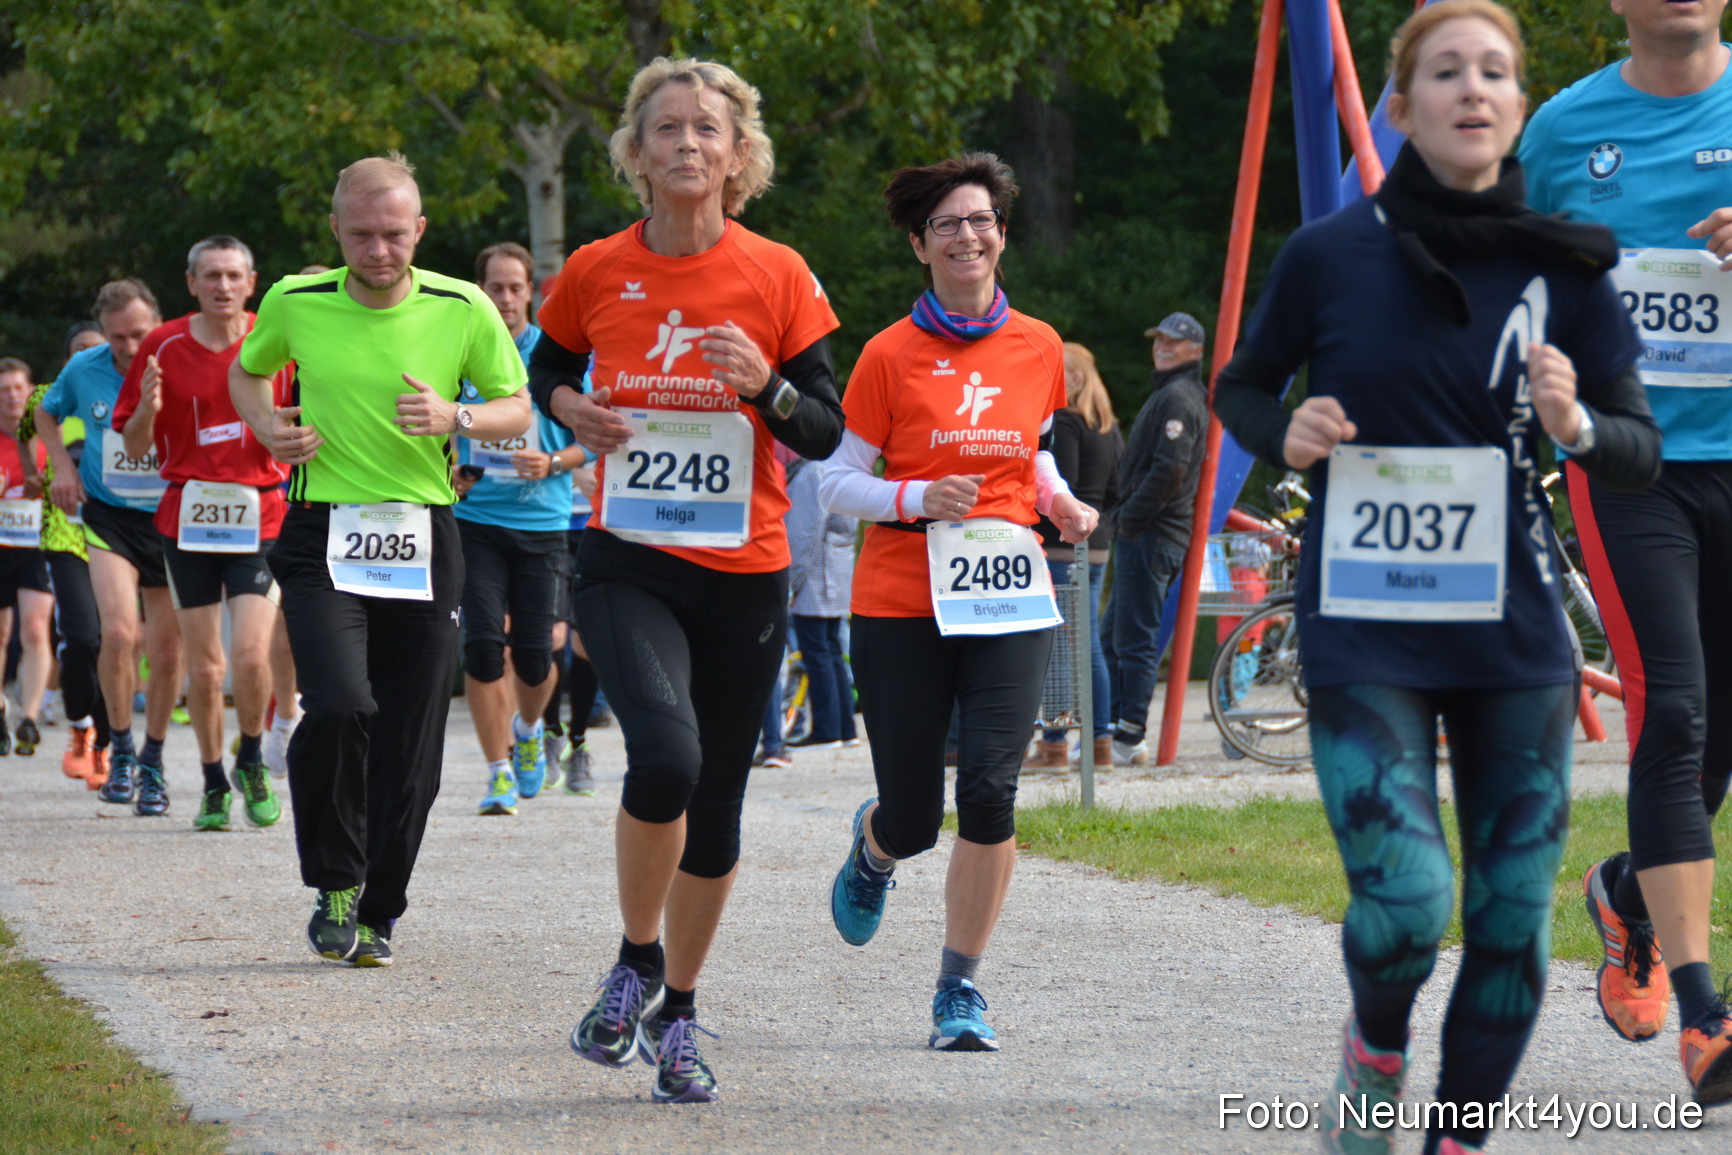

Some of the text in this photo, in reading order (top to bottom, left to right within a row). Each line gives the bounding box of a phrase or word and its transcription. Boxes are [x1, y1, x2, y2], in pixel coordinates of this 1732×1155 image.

[1590, 182, 1622, 197] PARTL
[1651, 262, 1701, 274] BOCK
[1620, 290, 1719, 334] 2583
[1644, 346, 1686, 362] David
[932, 368, 956, 376] erima
[614, 370, 725, 393] funrunners
[647, 392, 740, 410] neumarkt
[662, 422, 712, 435] BOCK
[930, 428, 1022, 449] funrunners
[959, 443, 1032, 460] neumarkt
[626, 450, 730, 494] 2248
[192, 503, 247, 524] 2317
[370, 511, 406, 520] BOCK
[655, 506, 696, 525] Helga
[976, 529, 1014, 539] BOCK
[1351, 500, 1476, 552] 2037
[206, 530, 232, 540] Martin
[344, 532, 416, 561] 2035
[366, 570, 392, 582] Peter
[949, 554, 1032, 592] 2489
[1385, 571, 1438, 588] Maria
[973, 603, 1018, 617] Brigitte
